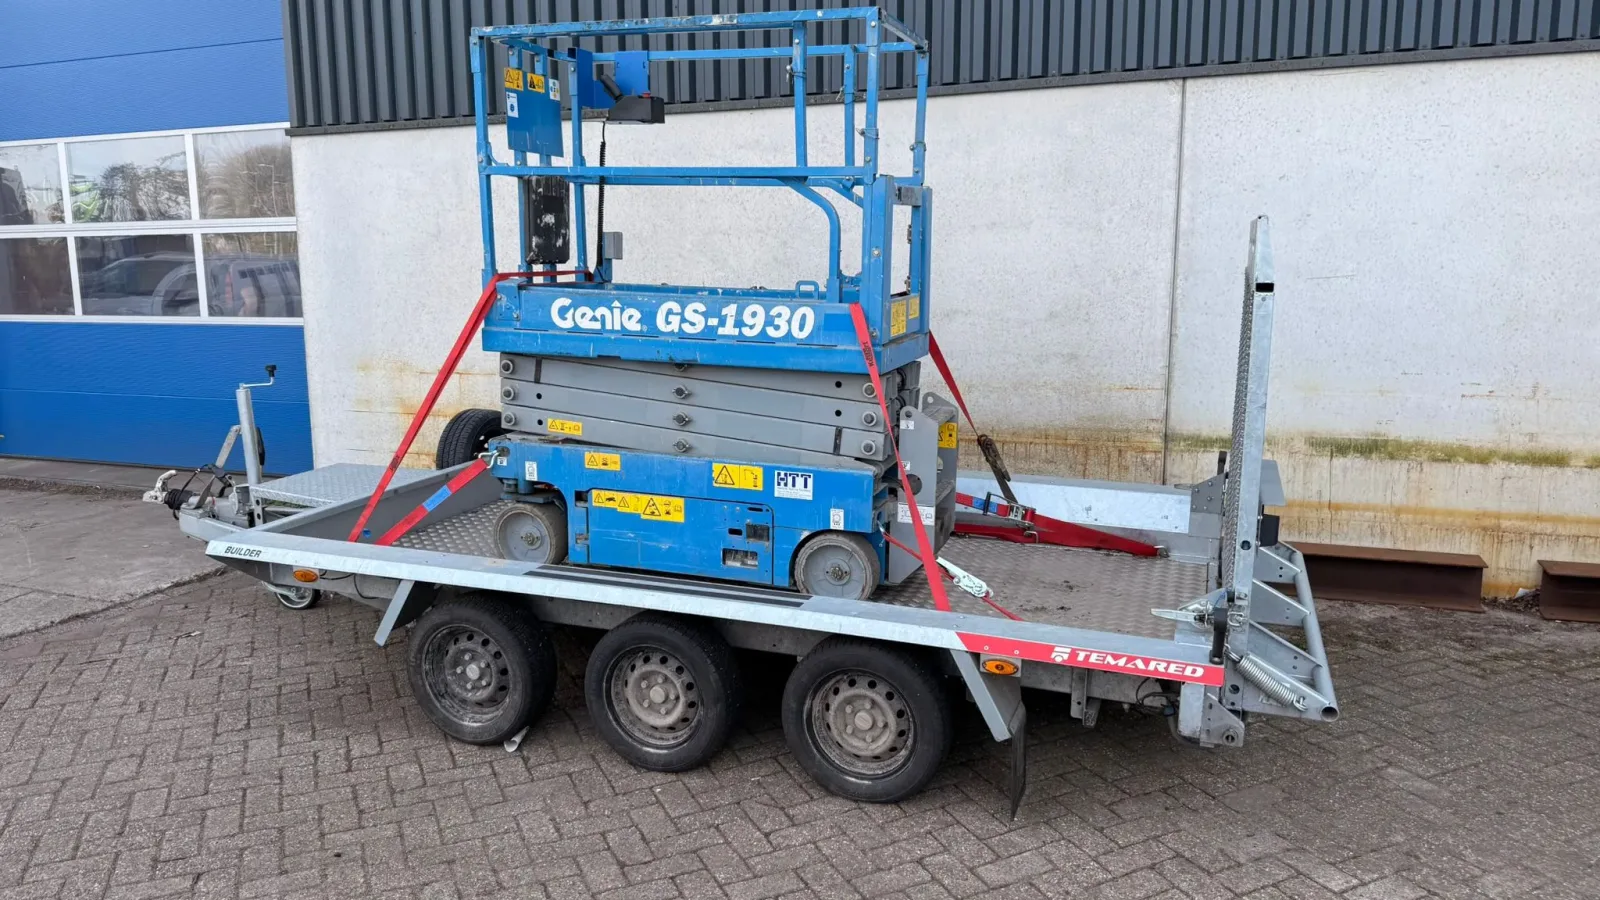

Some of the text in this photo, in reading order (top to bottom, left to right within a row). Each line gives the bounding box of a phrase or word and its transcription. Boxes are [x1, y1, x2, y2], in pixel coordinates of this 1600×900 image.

[550, 297, 815, 339] Genie GS-1930
[776, 471, 811, 489] HTT
[224, 546, 262, 558] BUILDER
[1075, 650, 1205, 678] TEMARED
